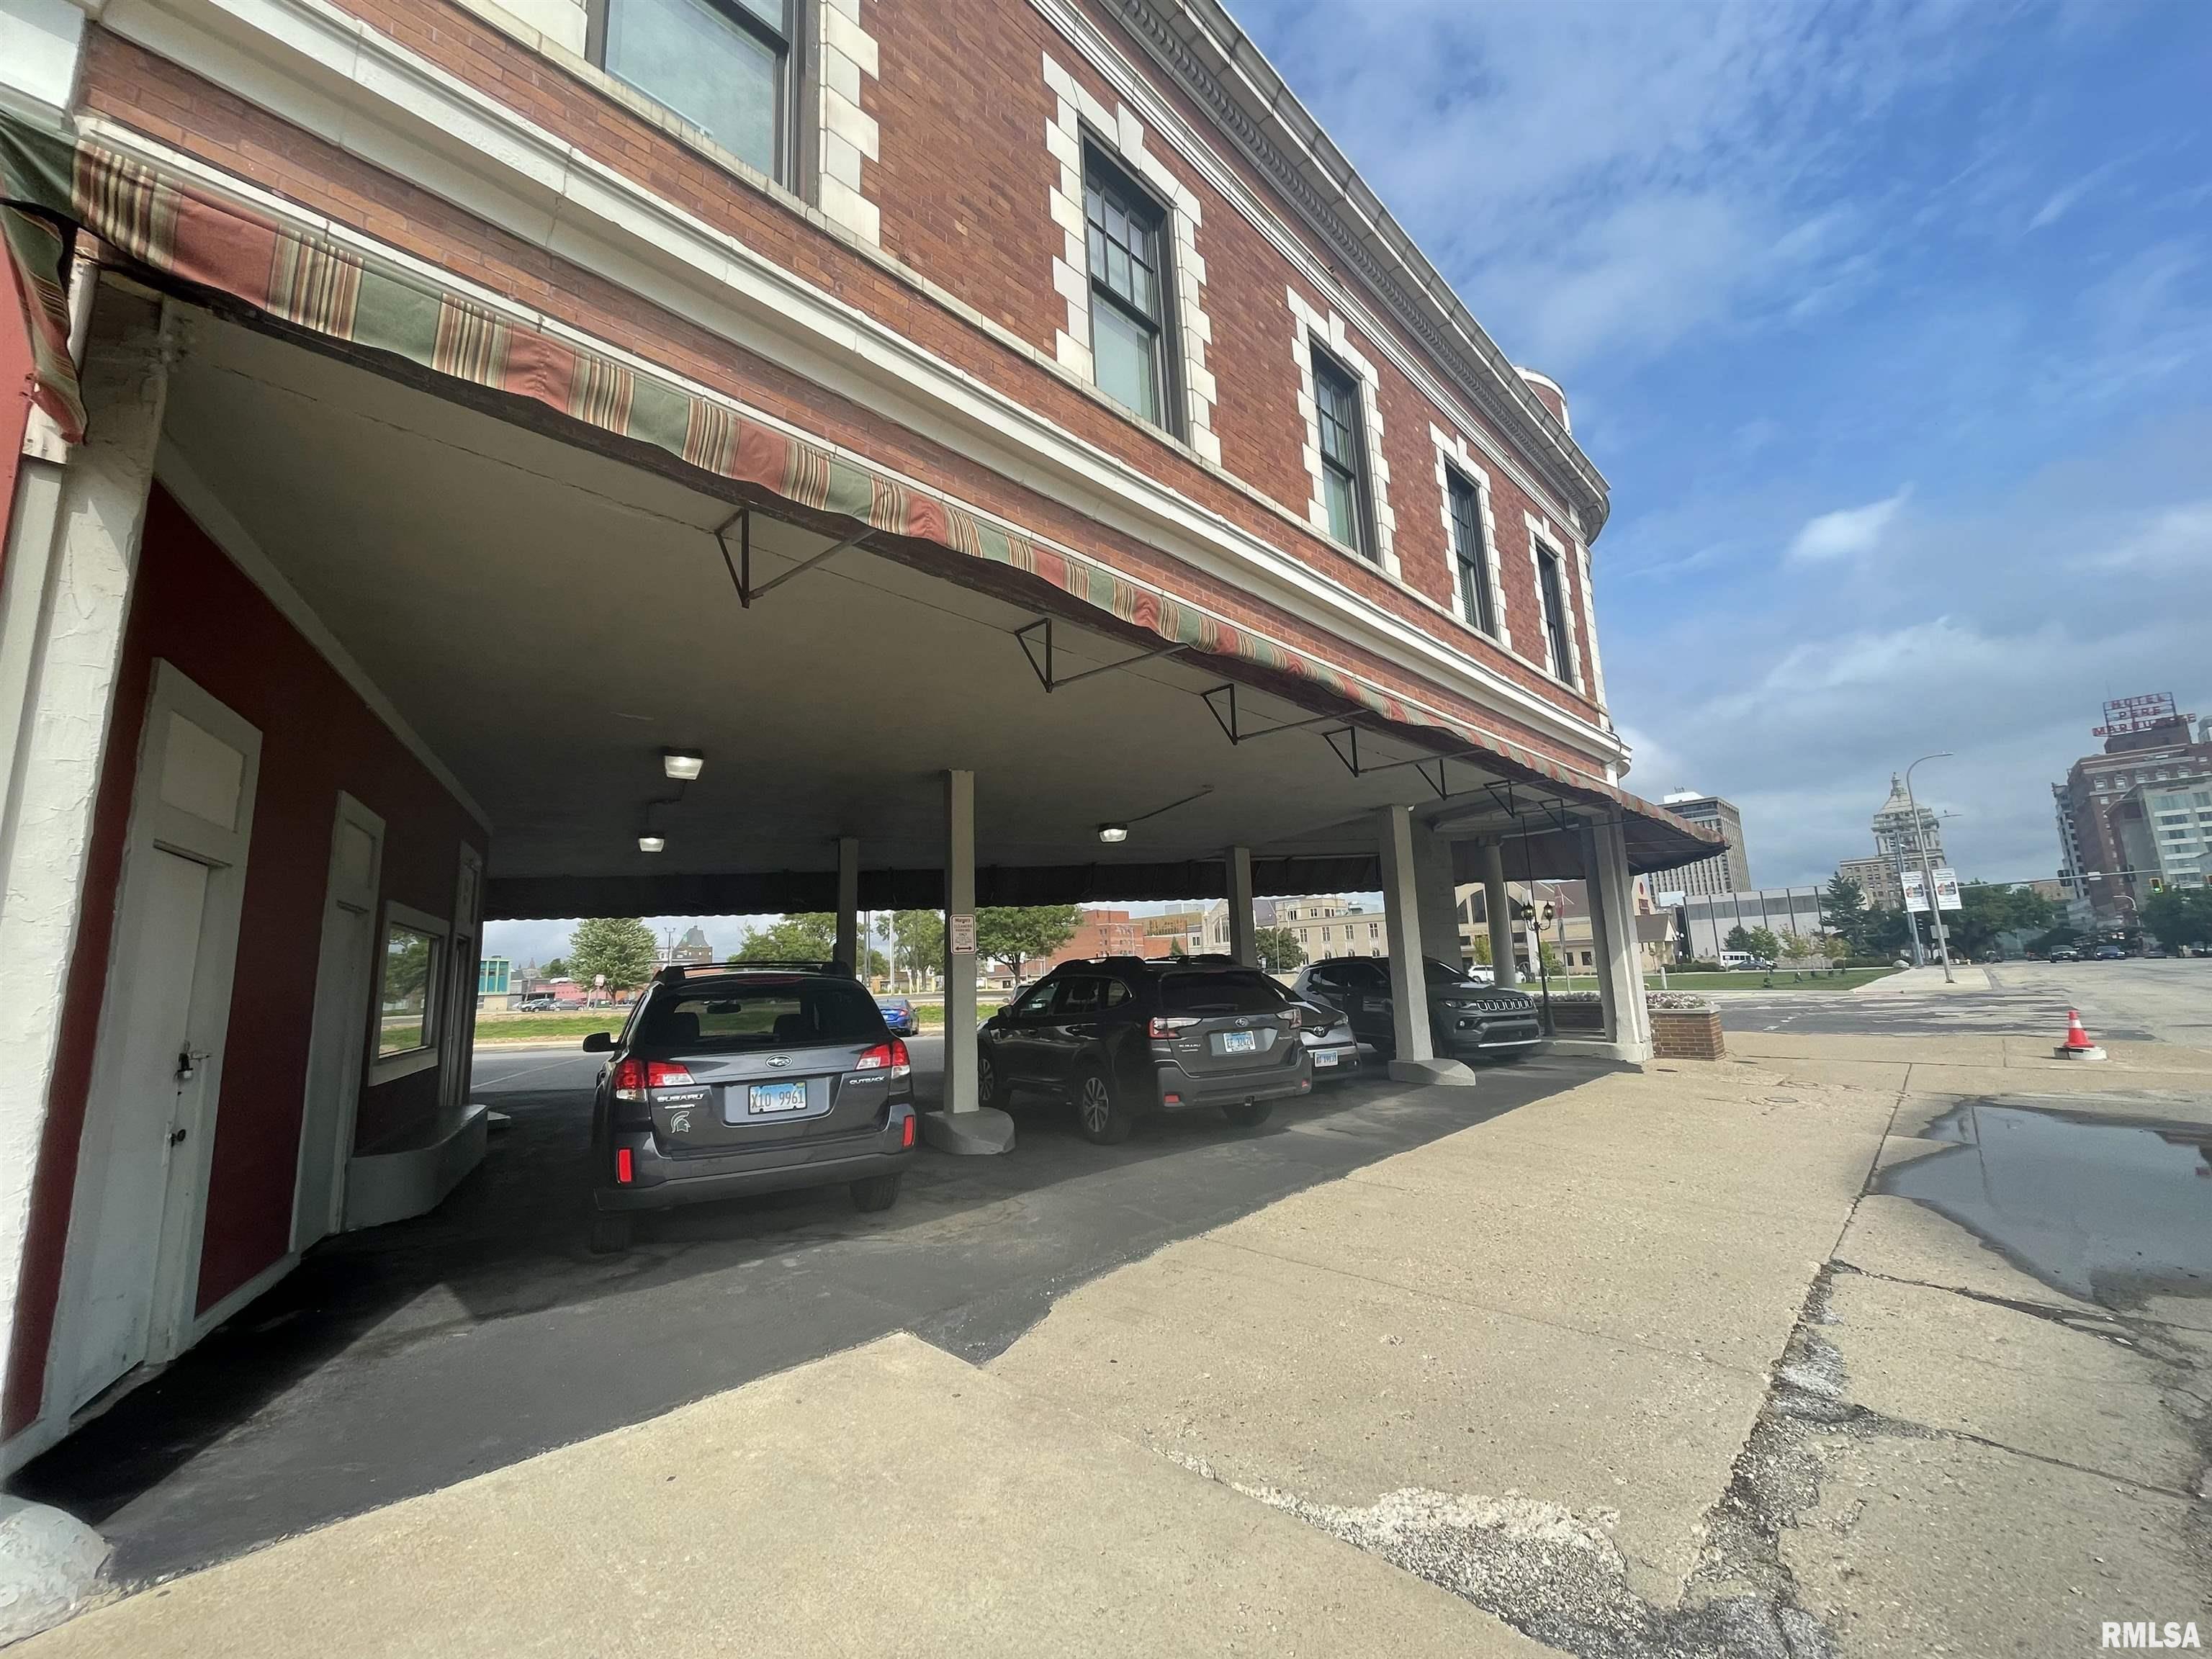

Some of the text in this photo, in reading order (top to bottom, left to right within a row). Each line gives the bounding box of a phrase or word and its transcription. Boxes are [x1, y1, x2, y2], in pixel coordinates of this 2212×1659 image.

[2119, 706, 2161, 719] PERE
[849, 1076, 886, 1085] OUTBACK
[657, 1093, 704, 1102] SUBARU
[751, 1089, 804, 1109] X10 9961
